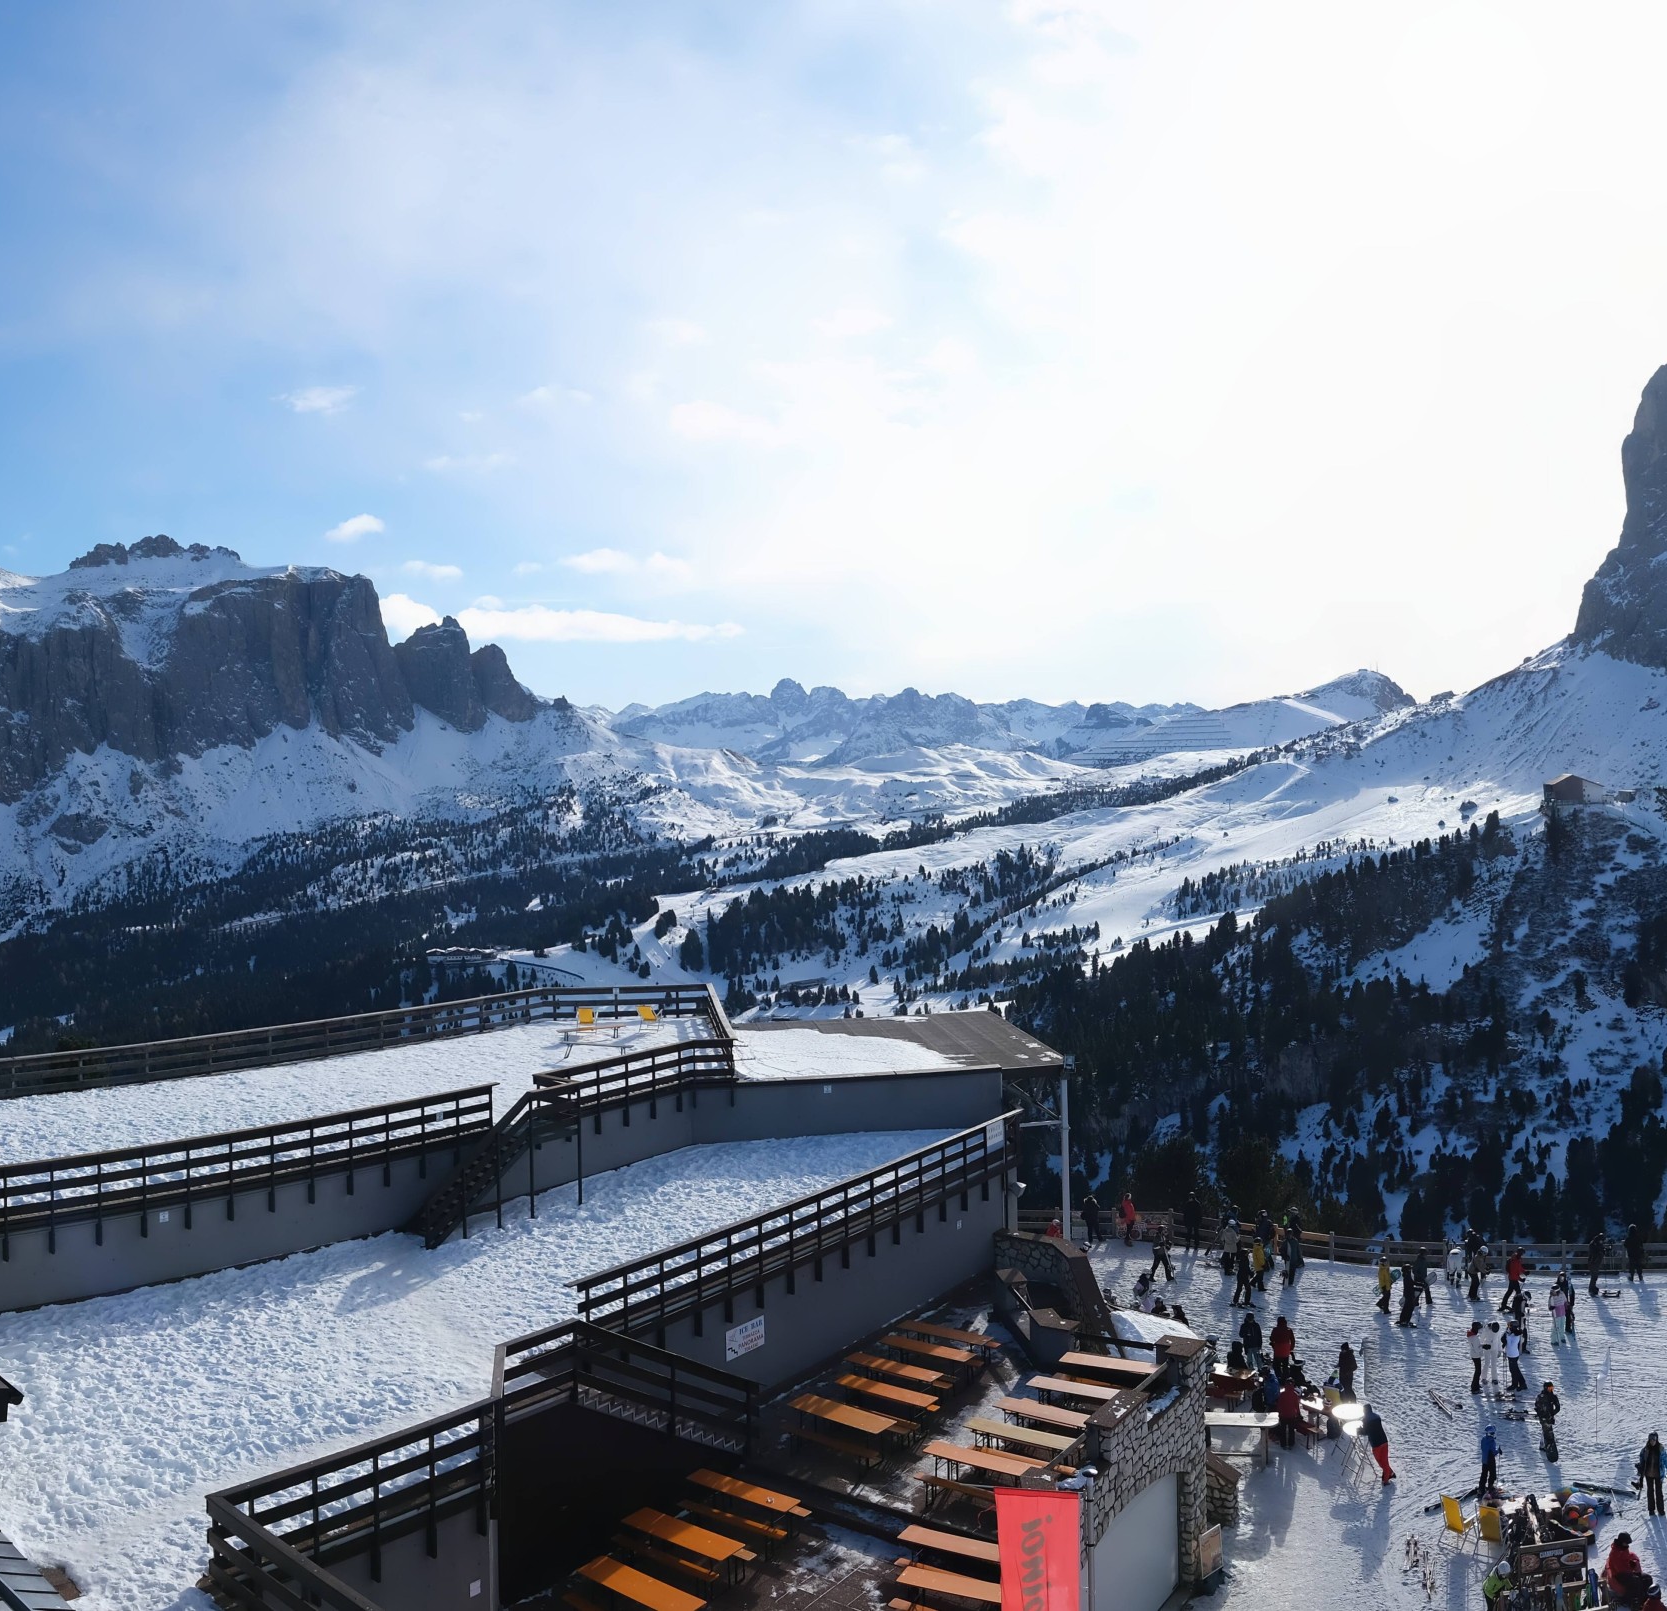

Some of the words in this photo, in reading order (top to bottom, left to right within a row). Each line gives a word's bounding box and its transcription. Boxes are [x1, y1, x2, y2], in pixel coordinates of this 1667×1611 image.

[740, 1326, 748, 1335] ICE
[750, 1320, 762, 1329] BAR
[738, 1334, 764, 1349] PANORAMA
